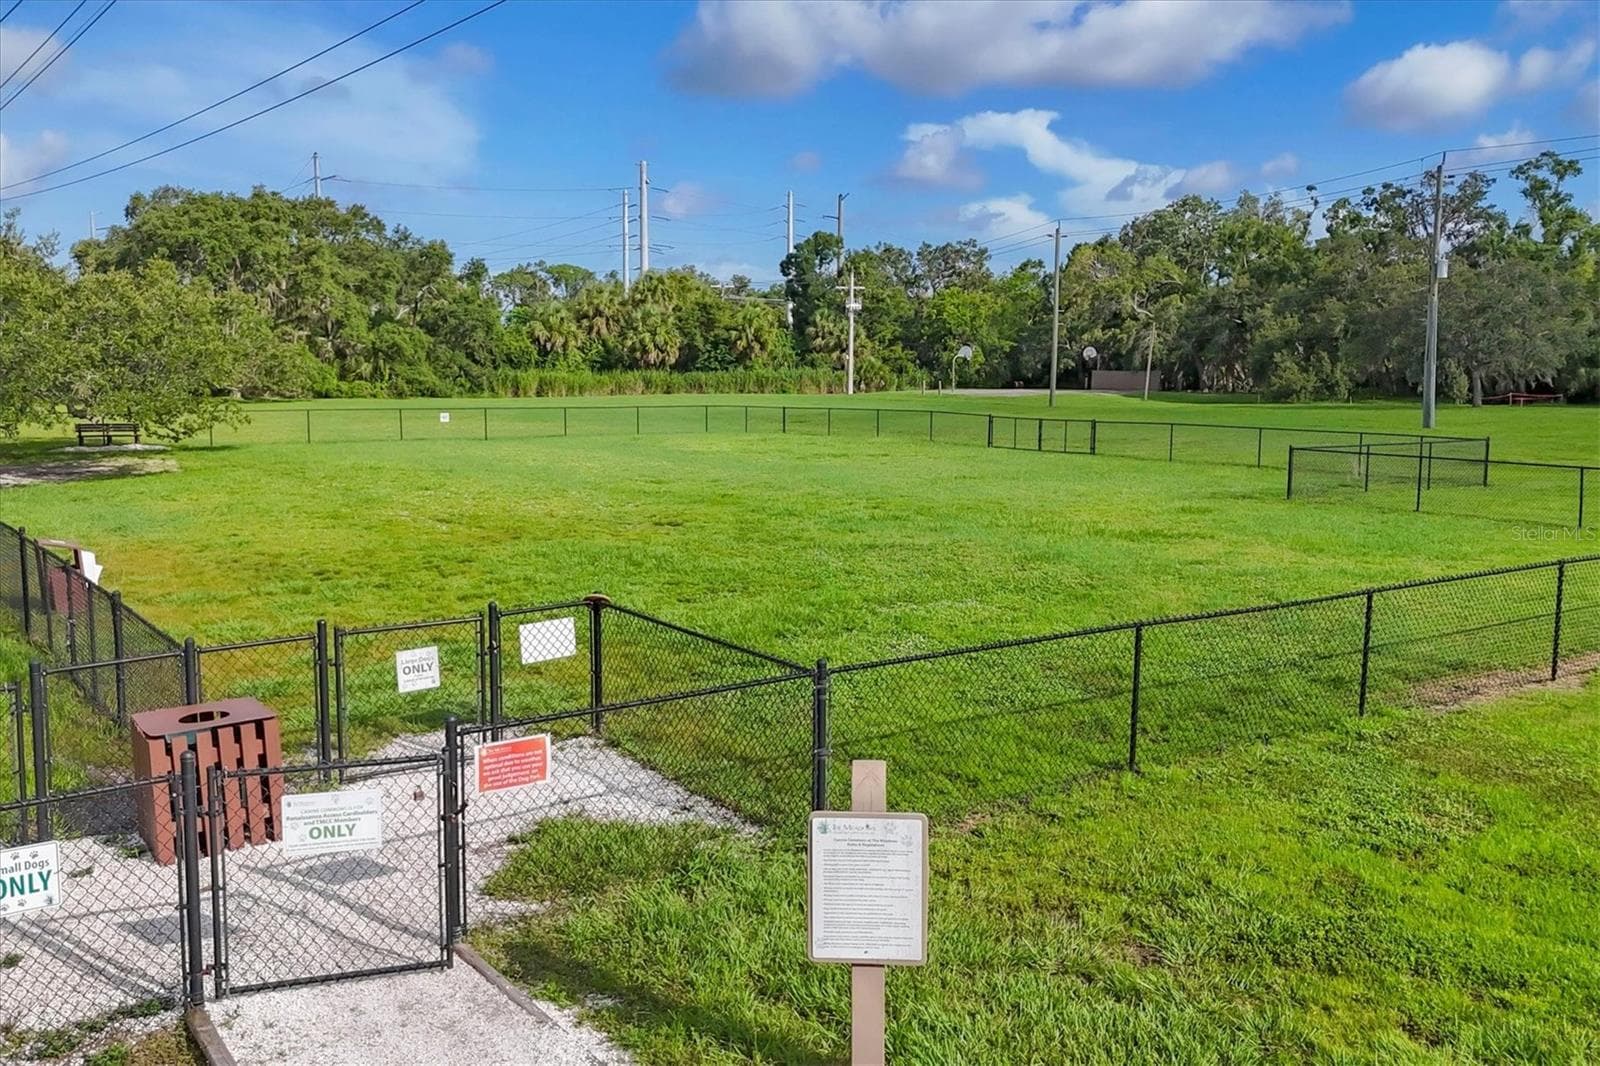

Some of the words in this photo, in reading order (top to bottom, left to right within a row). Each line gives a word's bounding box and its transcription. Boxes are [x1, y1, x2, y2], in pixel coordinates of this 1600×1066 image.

[403, 661, 434, 675] ONLY
[308, 823, 356, 840] ONLY
[0, 862, 21, 875] mall
[24, 859, 50, 870] Dogs
